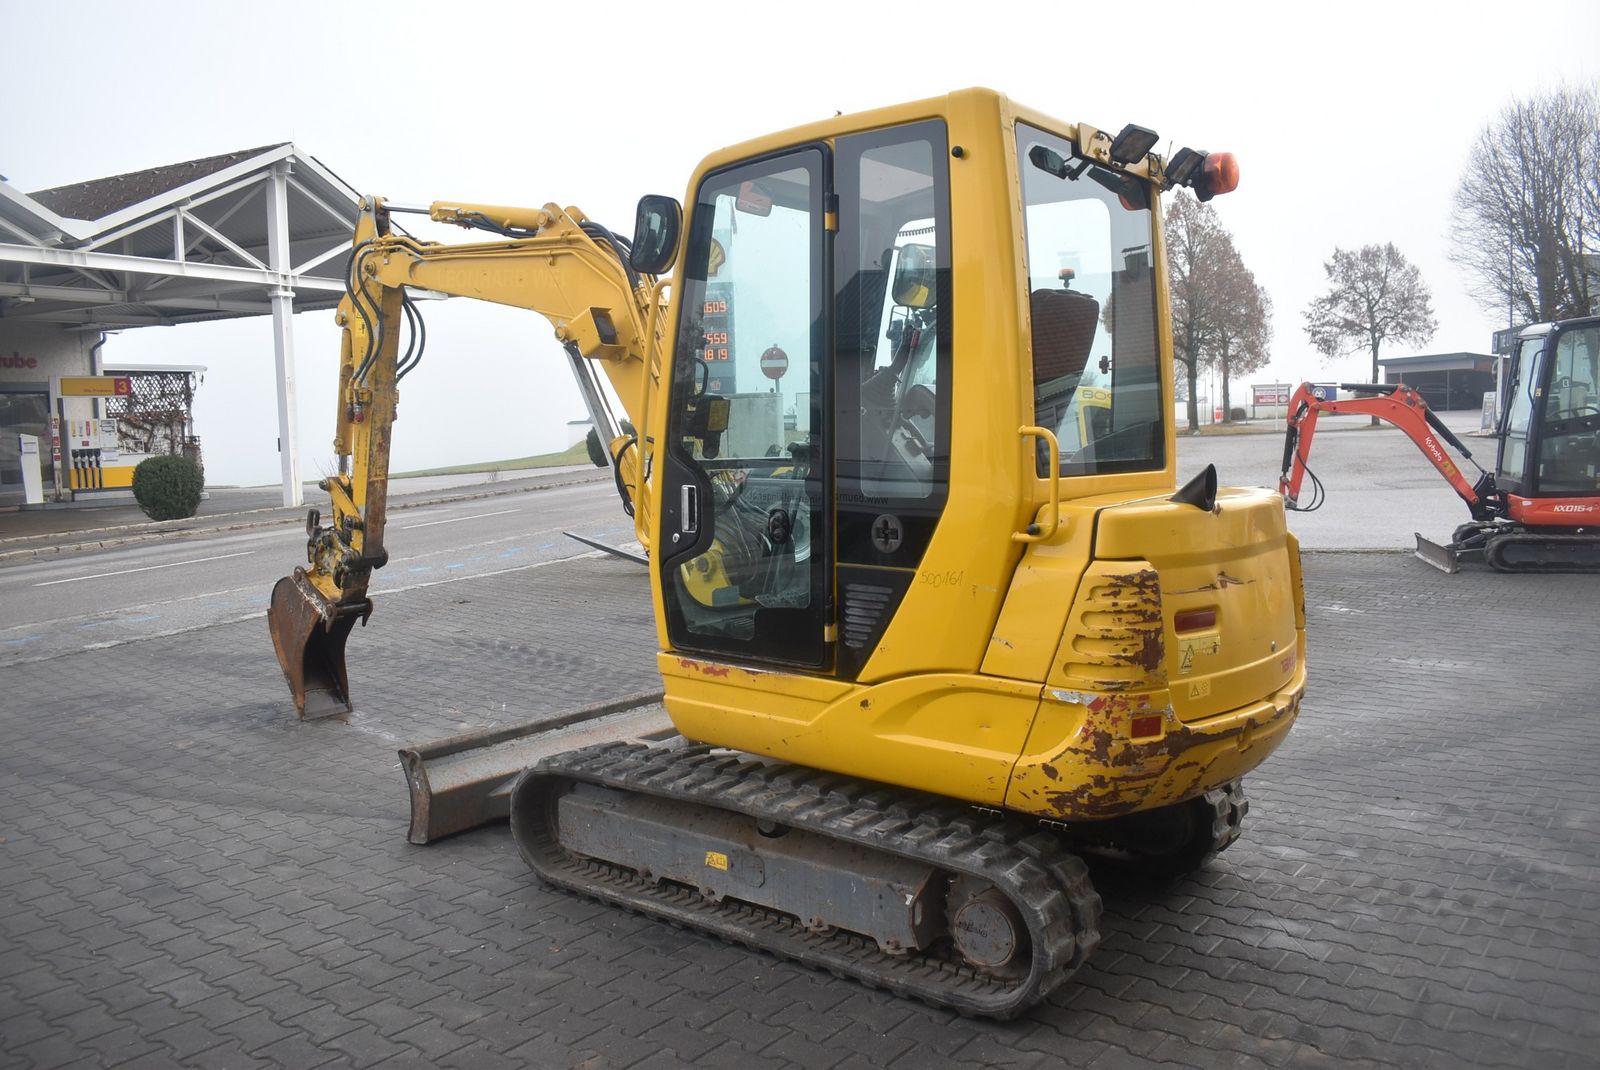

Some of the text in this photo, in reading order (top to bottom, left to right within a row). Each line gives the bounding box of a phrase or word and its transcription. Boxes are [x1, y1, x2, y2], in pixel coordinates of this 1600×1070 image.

[0, 351, 38, 368] ube
[118, 382, 128, 394] 3
[1425, 436, 1443, 462] Kubota
